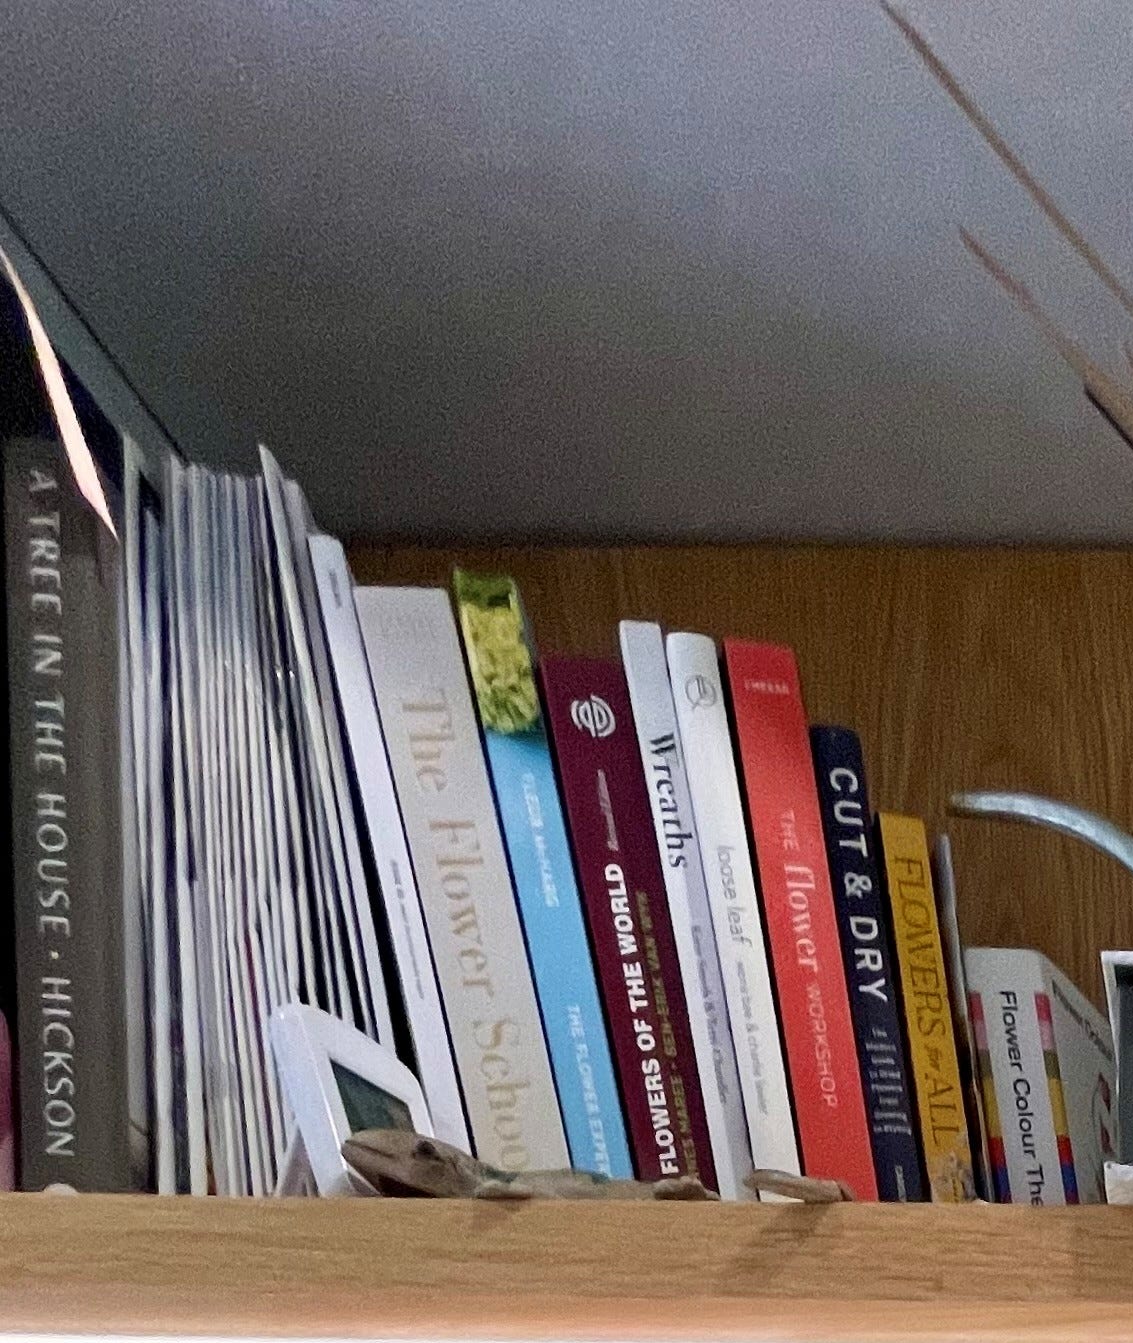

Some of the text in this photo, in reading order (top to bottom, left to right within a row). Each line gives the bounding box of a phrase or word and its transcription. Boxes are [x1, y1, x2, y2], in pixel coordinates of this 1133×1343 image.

[29, 468, 76, 1158] A TREE IN THE HOUSE HICKSON
[650, 733, 693, 869] Wreaths
[829, 767, 868, 858] CUT
[402, 688, 455, 793] The
[429, 818, 495, 997] Flower
[472, 1014, 531, 1170] Schoo
[604, 863, 638, 956] WORLD
[717, 845, 753, 949] loose leaf
[844, 872, 872, 899] &
[623, 961, 649, 1014] THE
[780, 809, 838, 1108] THE flower WORKSHOP
[850, 916, 889, 1003] DRY
[894, 853, 947, 1038] FLOWERS
[924, 1071, 961, 1147] ALL
[568, 1004, 585, 1039] THE
[589, 1120, 612, 1178] EXPER
[633, 1018, 656, 1052] OF
[641, 1057, 679, 1175] FLOWERS
[1000, 990, 1045, 1207] Flower Colour The
